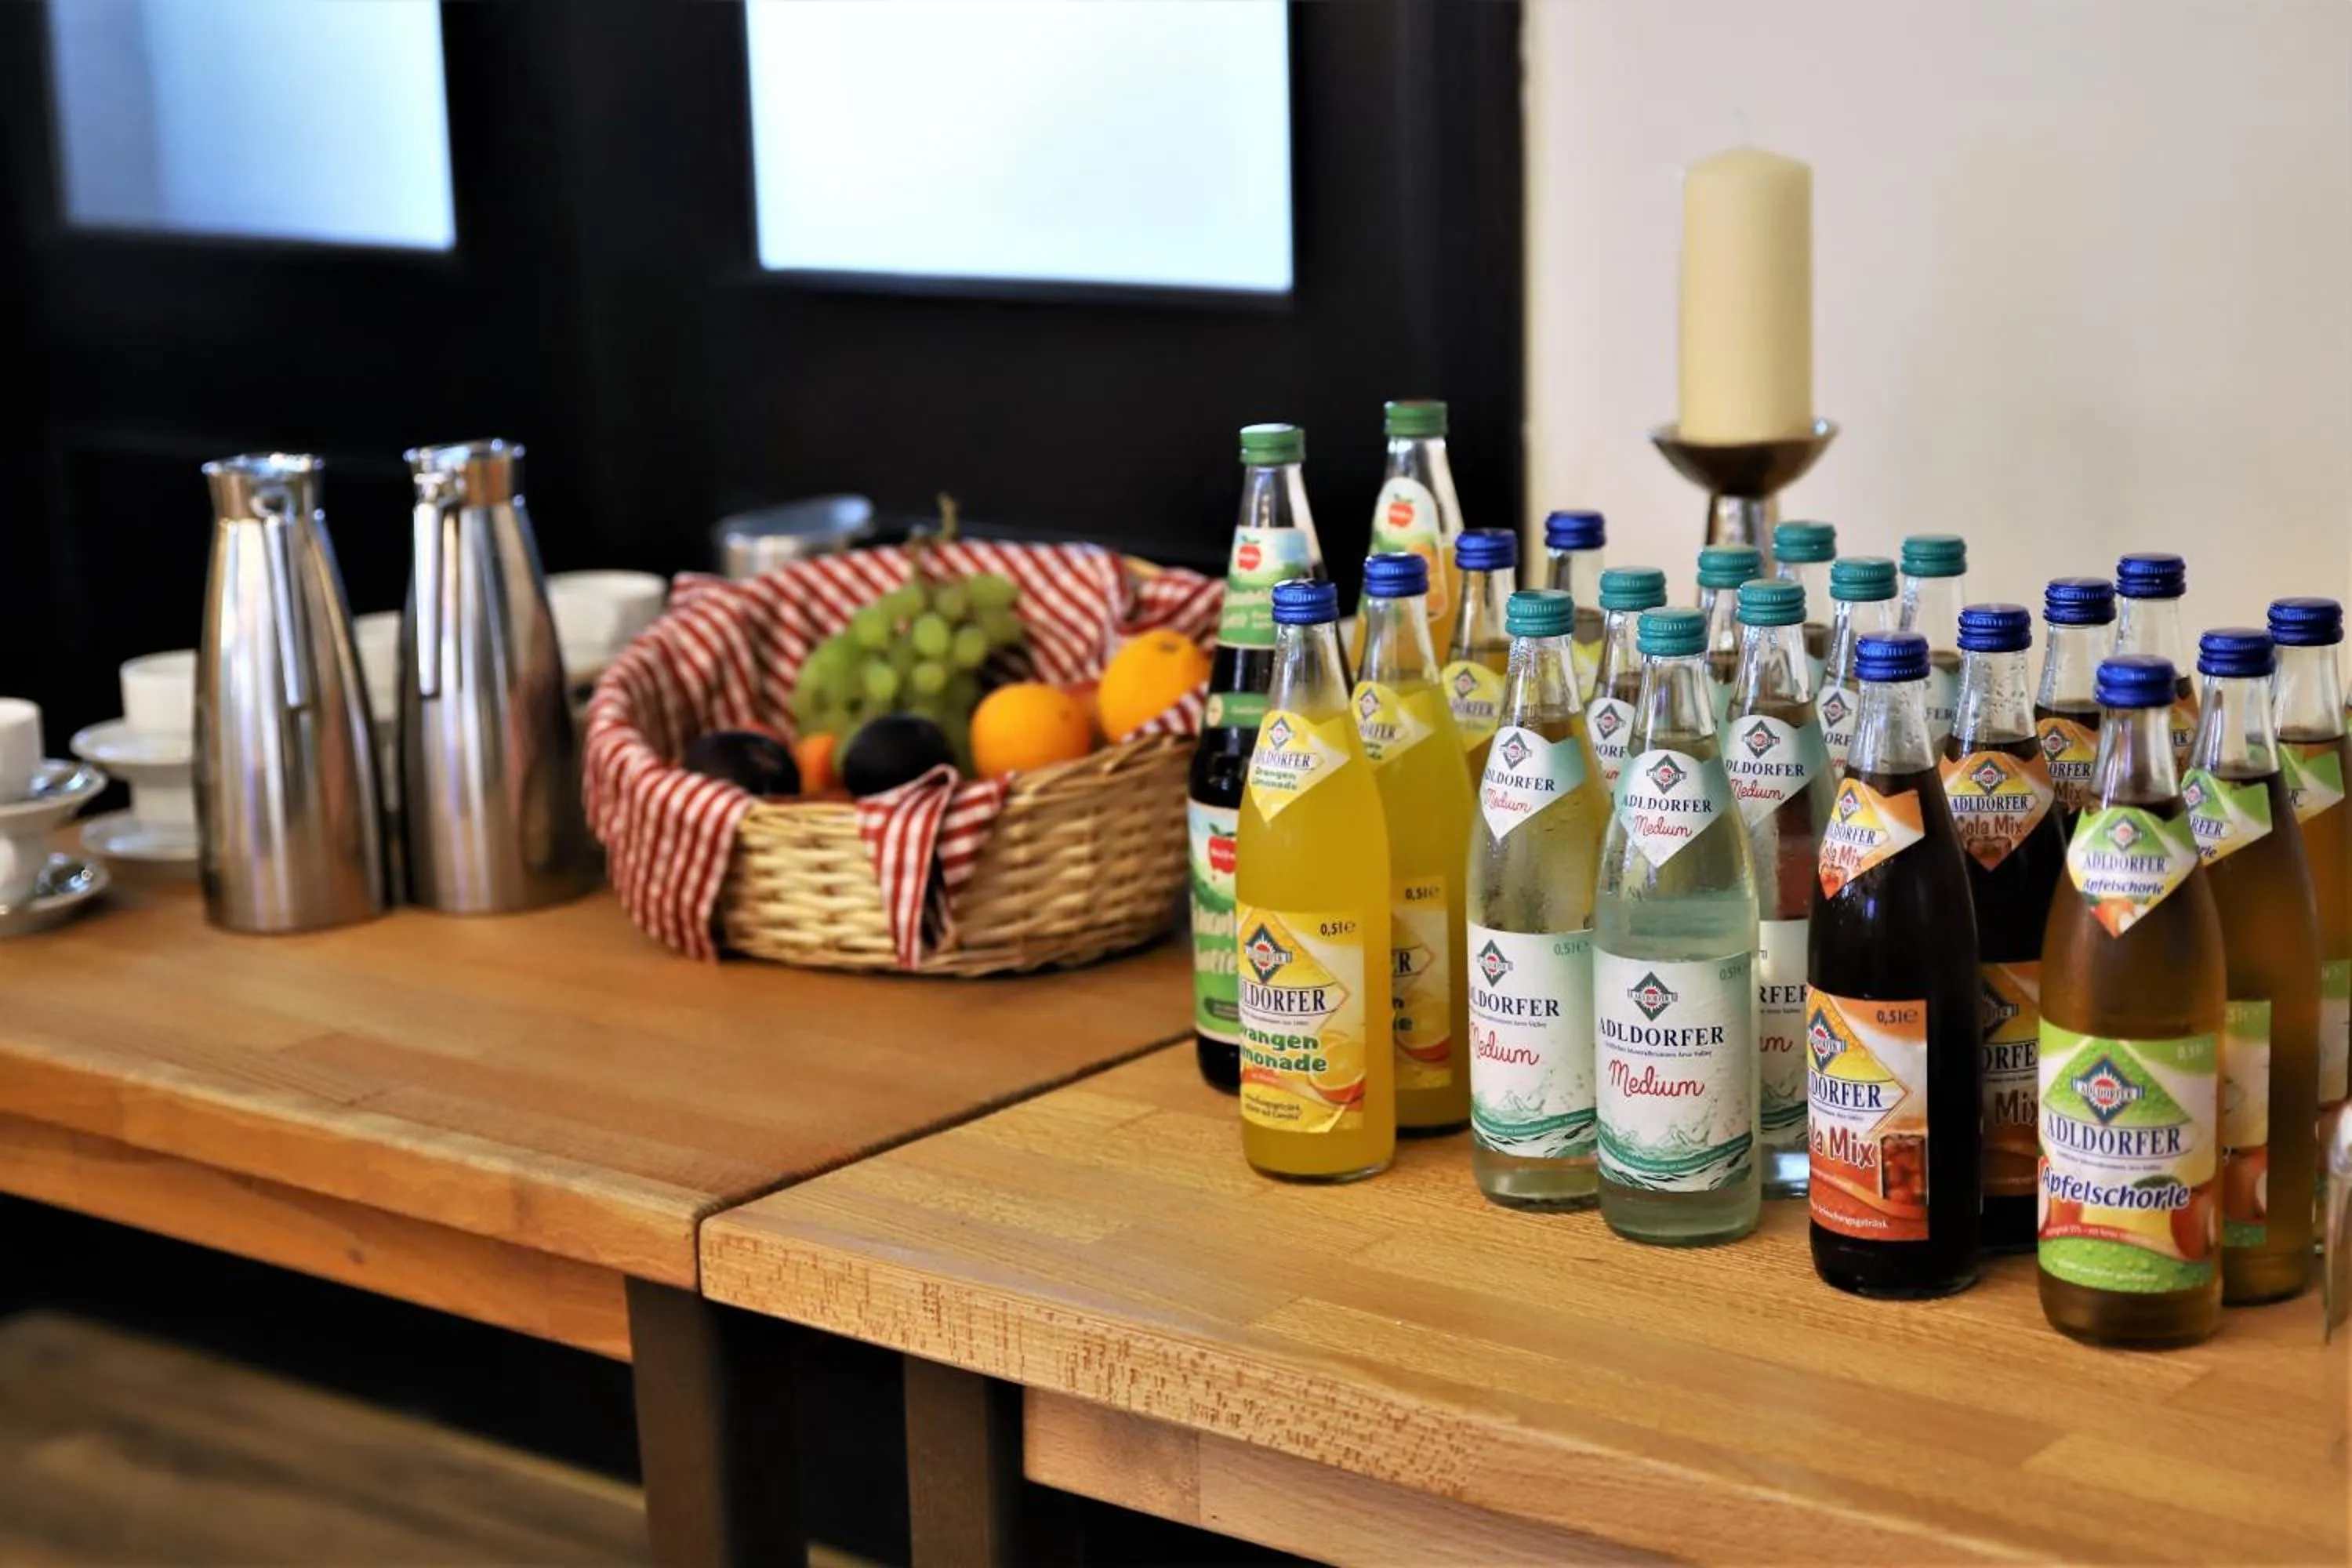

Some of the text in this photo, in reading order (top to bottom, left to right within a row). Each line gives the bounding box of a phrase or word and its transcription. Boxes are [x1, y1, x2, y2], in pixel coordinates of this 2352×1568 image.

[1726, 760, 1806, 777] DLDORFER
[2049, 763, 2092, 779] ORFER
[1621, 794, 1713, 814] ADLDORFER
[1951, 796, 2029, 811] ADLDORFER
[1634, 815, 1693, 838] Medium
[1994, 814, 2024, 836] Mix
[2085, 851, 2166, 873] ADLDORFER
[1242, 1027, 1319, 1051] rangen
[1599, 1017, 1725, 1047] ADLDORFER
[1609, 1059, 1706, 1098] Medium
[1809, 1071, 1883, 1109] DORFER
[2046, 1112, 2181, 1156] ADLDORFER
[1829, 1126, 1875, 1168] Mix
[2042, 1166, 2190, 1210] Apfelschorle
